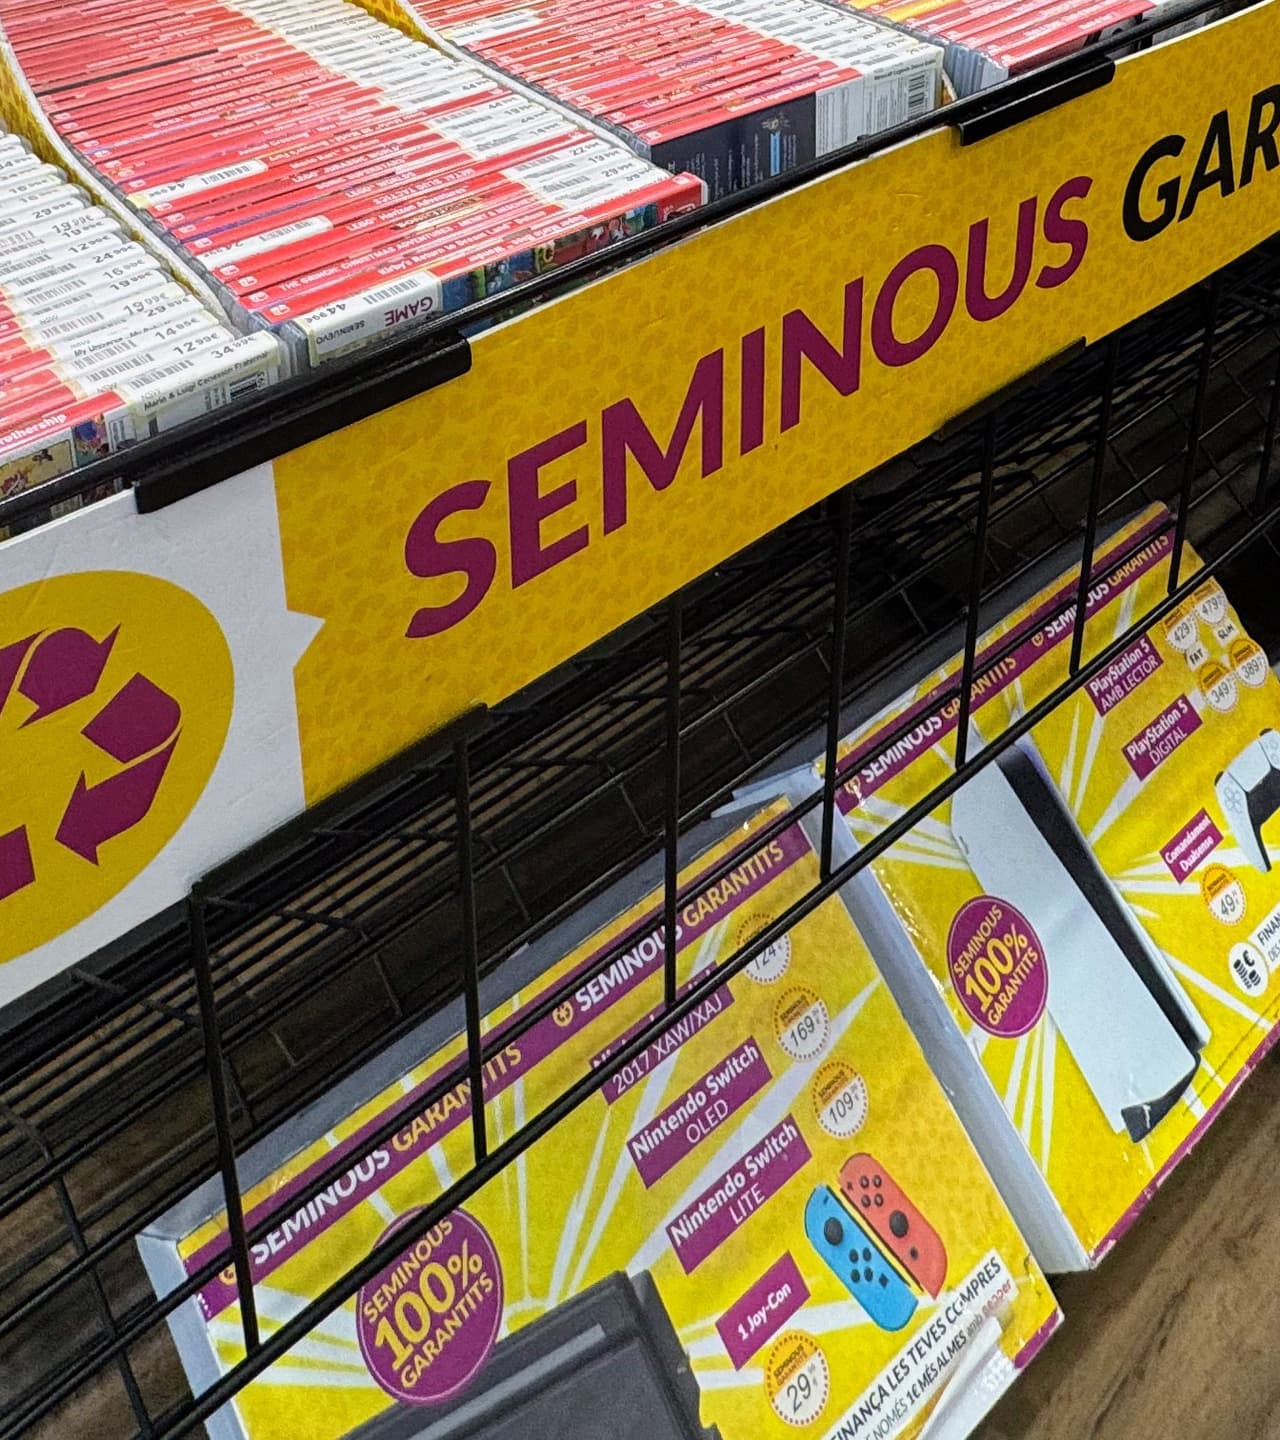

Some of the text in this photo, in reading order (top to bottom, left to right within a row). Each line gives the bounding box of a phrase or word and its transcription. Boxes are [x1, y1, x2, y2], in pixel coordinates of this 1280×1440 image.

[384, 296, 434, 327] GAME
[405, 175, 1094, 639] SEMINOUS
[1108, 533, 1171, 588] GARANTITS
[1089, 648, 1141, 697] PlayStation
[1100, 654, 1159, 711] AMB LECTOR
[862, 714, 943, 784] SEMINOUS
[1126, 712, 1180, 760] PlayStation
[1149, 727, 1188, 766] DIGITAL
[1164, 815, 1212, 863] Comandament
[1179, 835, 1214, 873] Dualsense
[683, 844, 785, 927] GARANTITS
[952, 904, 1004, 977] SEMINOUS
[965, 924, 1029, 1014] 100%
[986, 948, 1039, 1027] GARANTITS
[789, 1013, 816, 1049] 169
[611, 1058, 653, 1095] 2017
[630, 1042, 761, 1160] Nintendo Switch
[685, 1098, 731, 1146] OLED
[827, 1095, 856, 1126] 109
[252, 1147, 391, 1264] SEMINOUS
[669, 1121, 799, 1248] Nintendo Switch
[730, 1185, 767, 1227] LITE
[363, 1217, 454, 1323] SEMINOUS
[374, 1237, 484, 1372] 100%
[399, 1273, 494, 1390] GARANTITS
[747, 1281, 793, 1335] Joy-Con
[888, 1320, 947, 1394] LES TEVES
[787, 1377, 813, 1412] 29
